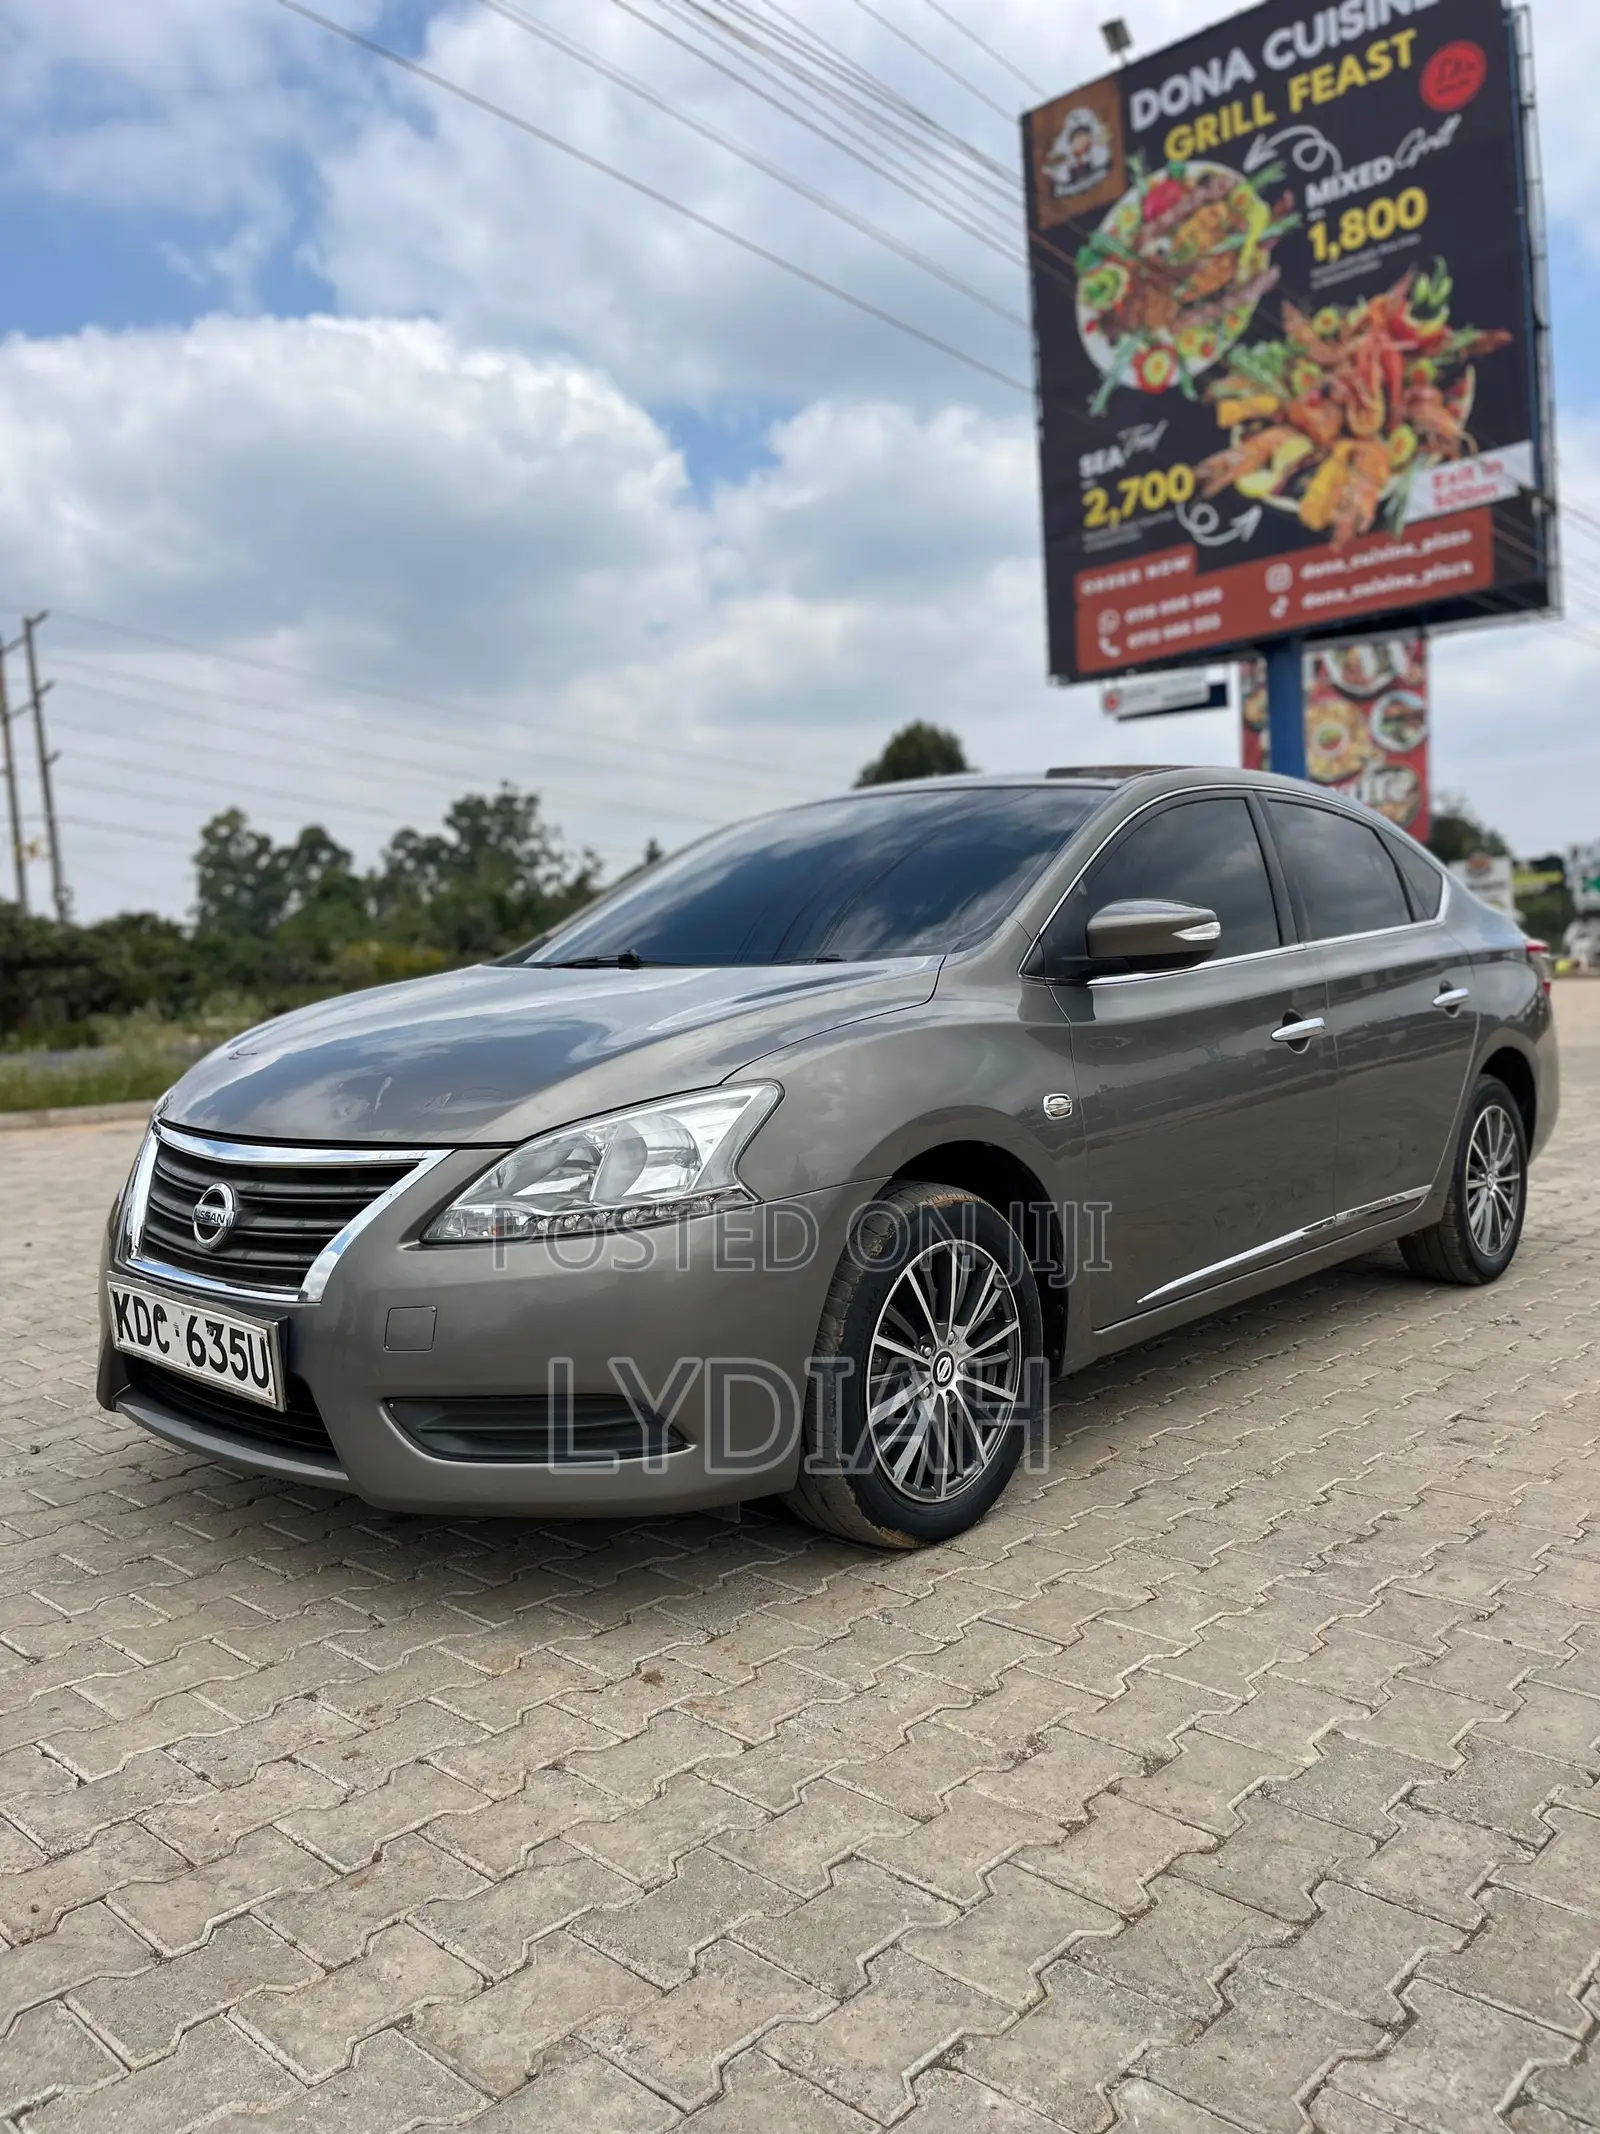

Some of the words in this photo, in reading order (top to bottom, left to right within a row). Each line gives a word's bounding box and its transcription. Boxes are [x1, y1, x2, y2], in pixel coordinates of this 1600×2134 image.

[1129, 46, 1256, 131] DONA
[1262, 0, 1441, 70] CUISIN
[1164, 91, 1276, 162] GRILL
[1288, 27, 1417, 113] FEAST
[1305, 155, 1395, 208] MIXED
[1307, 186, 1428, 262] 1,800
[1079, 445, 1126, 478] SEA
[1082, 463, 1195, 529] 2,700
[112, 1291, 170, 1354] KDC
[186, 1315, 270, 1388] 635U
